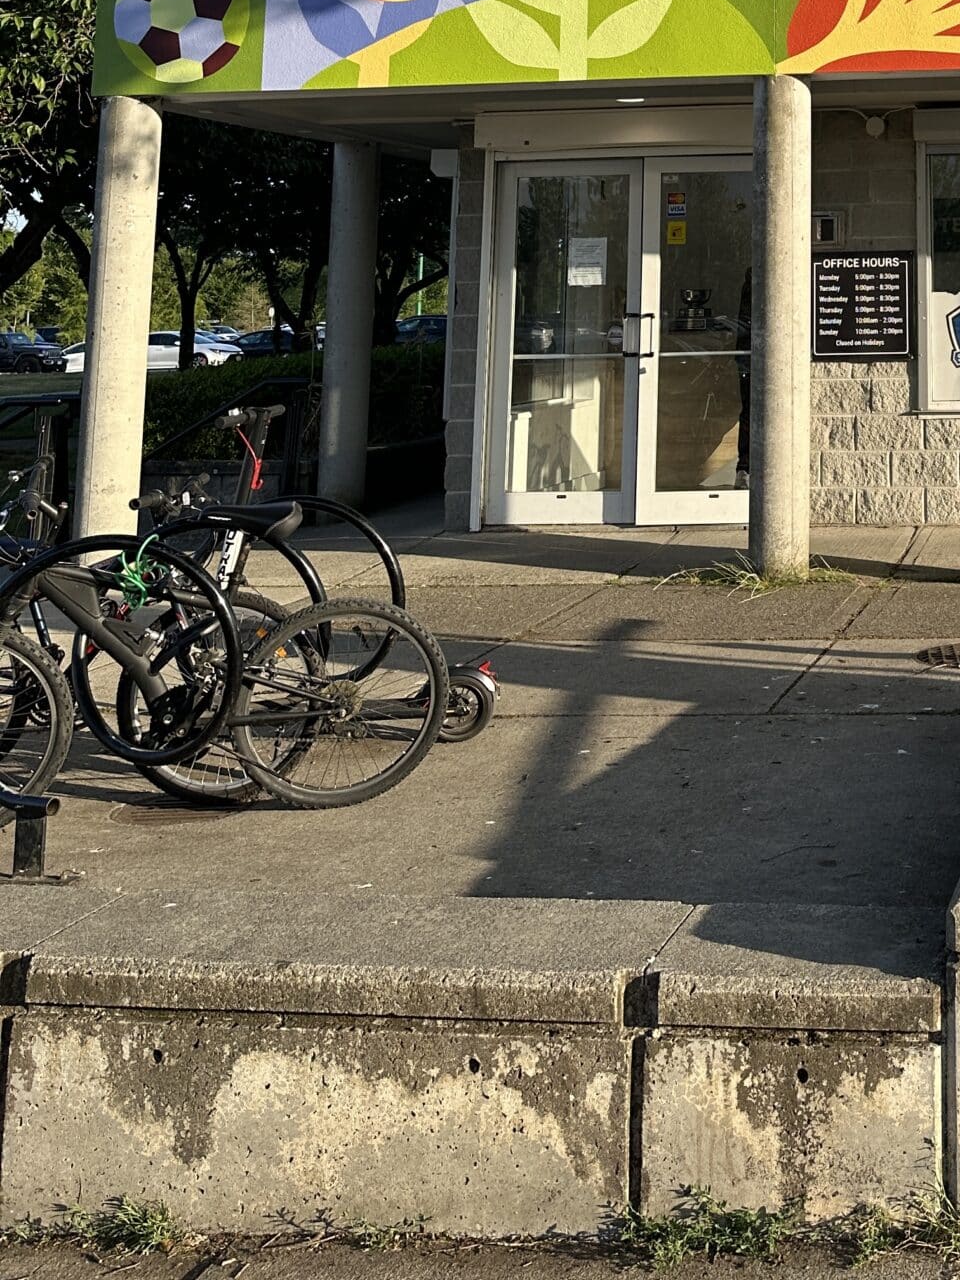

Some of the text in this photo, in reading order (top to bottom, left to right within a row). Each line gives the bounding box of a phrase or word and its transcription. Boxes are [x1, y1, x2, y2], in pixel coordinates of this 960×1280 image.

[822, 257, 900, 269] OFFICE HOURS
[819, 274, 840, 282] Monday
[819, 285, 840, 293] Tuesday
[819, 318, 842, 326] Saturday
[819, 328, 839, 336] Sunday
[862, 339, 885, 347] Holidays
